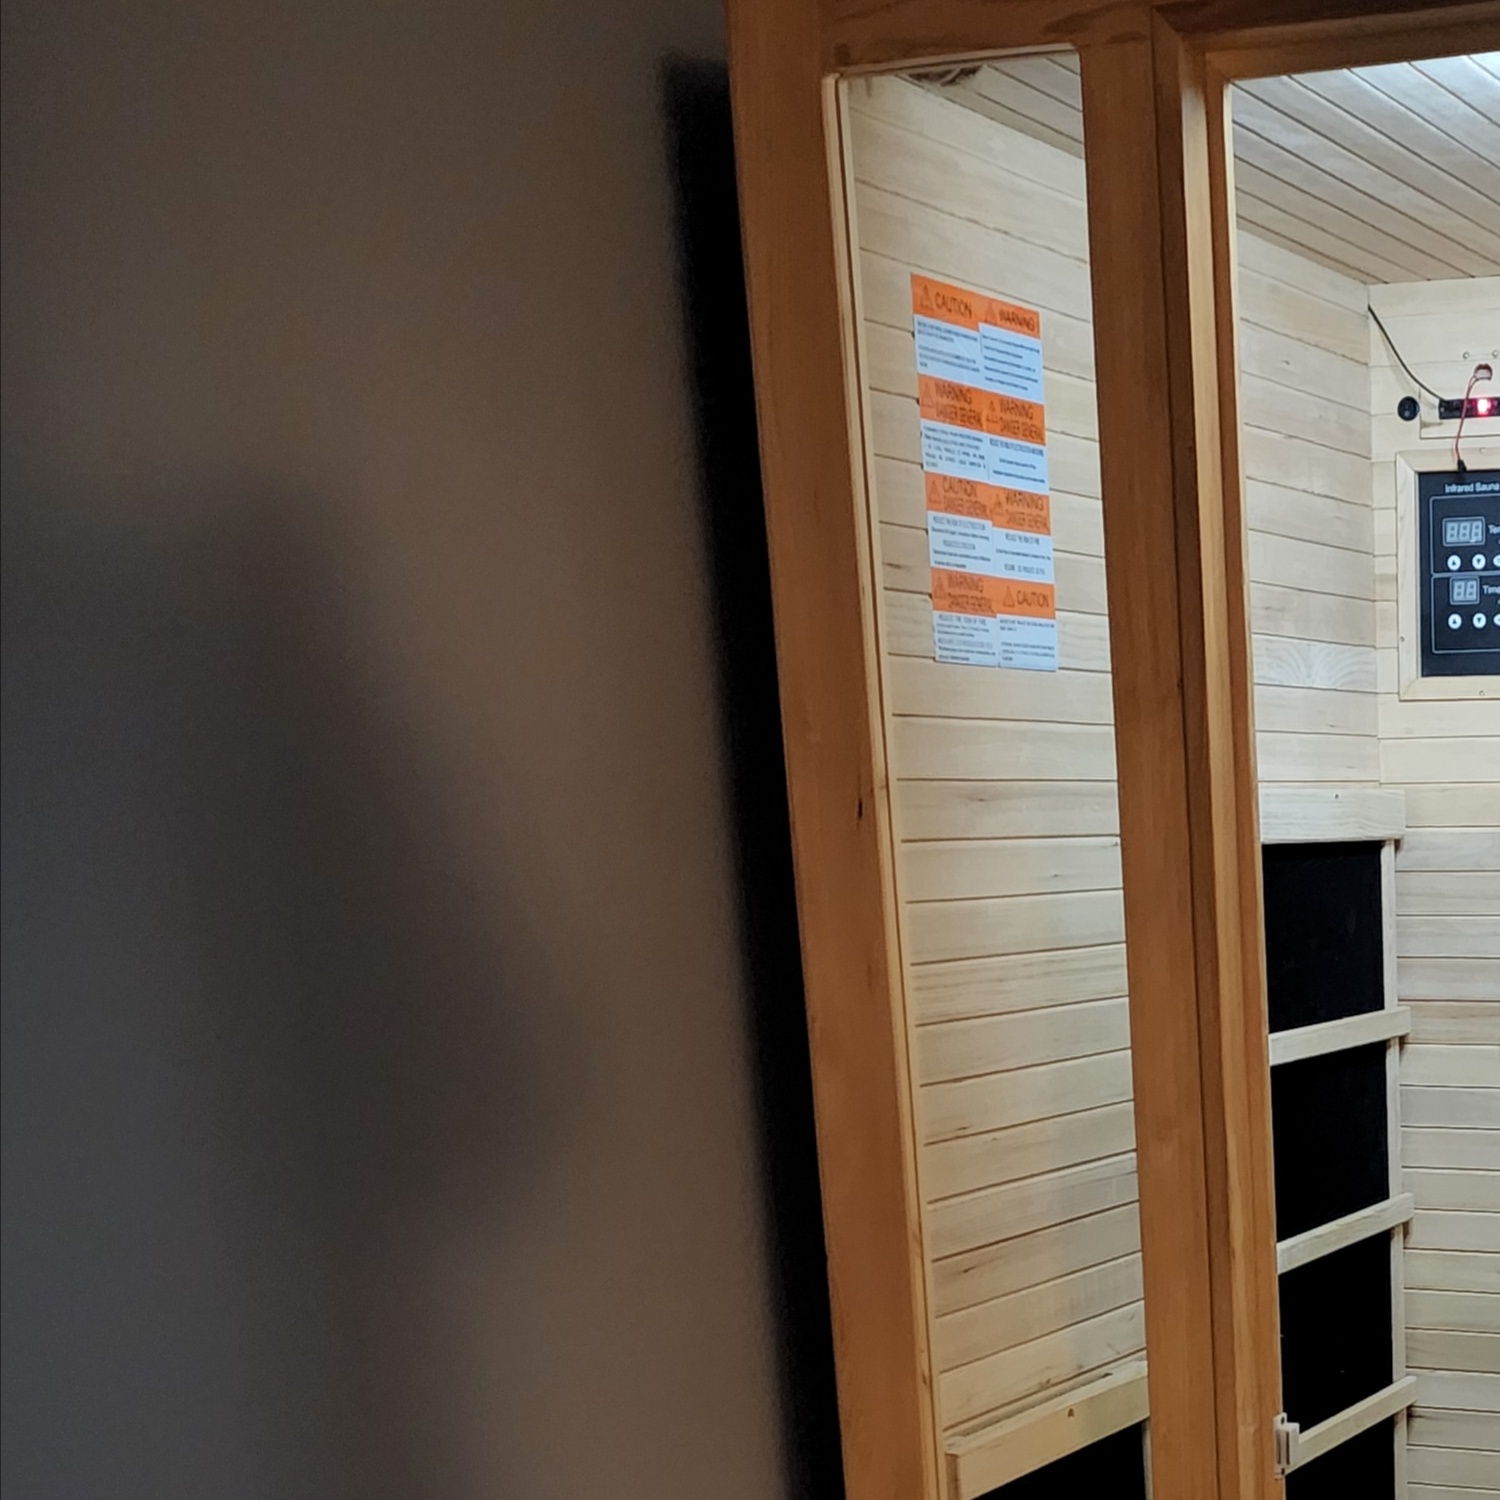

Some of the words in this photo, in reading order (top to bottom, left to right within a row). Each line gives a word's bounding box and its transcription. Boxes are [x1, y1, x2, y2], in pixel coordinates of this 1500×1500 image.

[935, 292, 972, 318] CAUTION
[999, 309, 1035, 332] WARNING
[935, 382, 973, 405] WARNING
[999, 398, 1034, 421] WARNING
[943, 476, 977, 498] CAUTION
[1445, 483, 1474, 493] Infrared
[1475, 482, 1500, 492] Sauna
[1006, 491, 1044, 511] WARNING
[946, 573, 984, 594] WARNING
[1016, 590, 1050, 609] CAUTION
